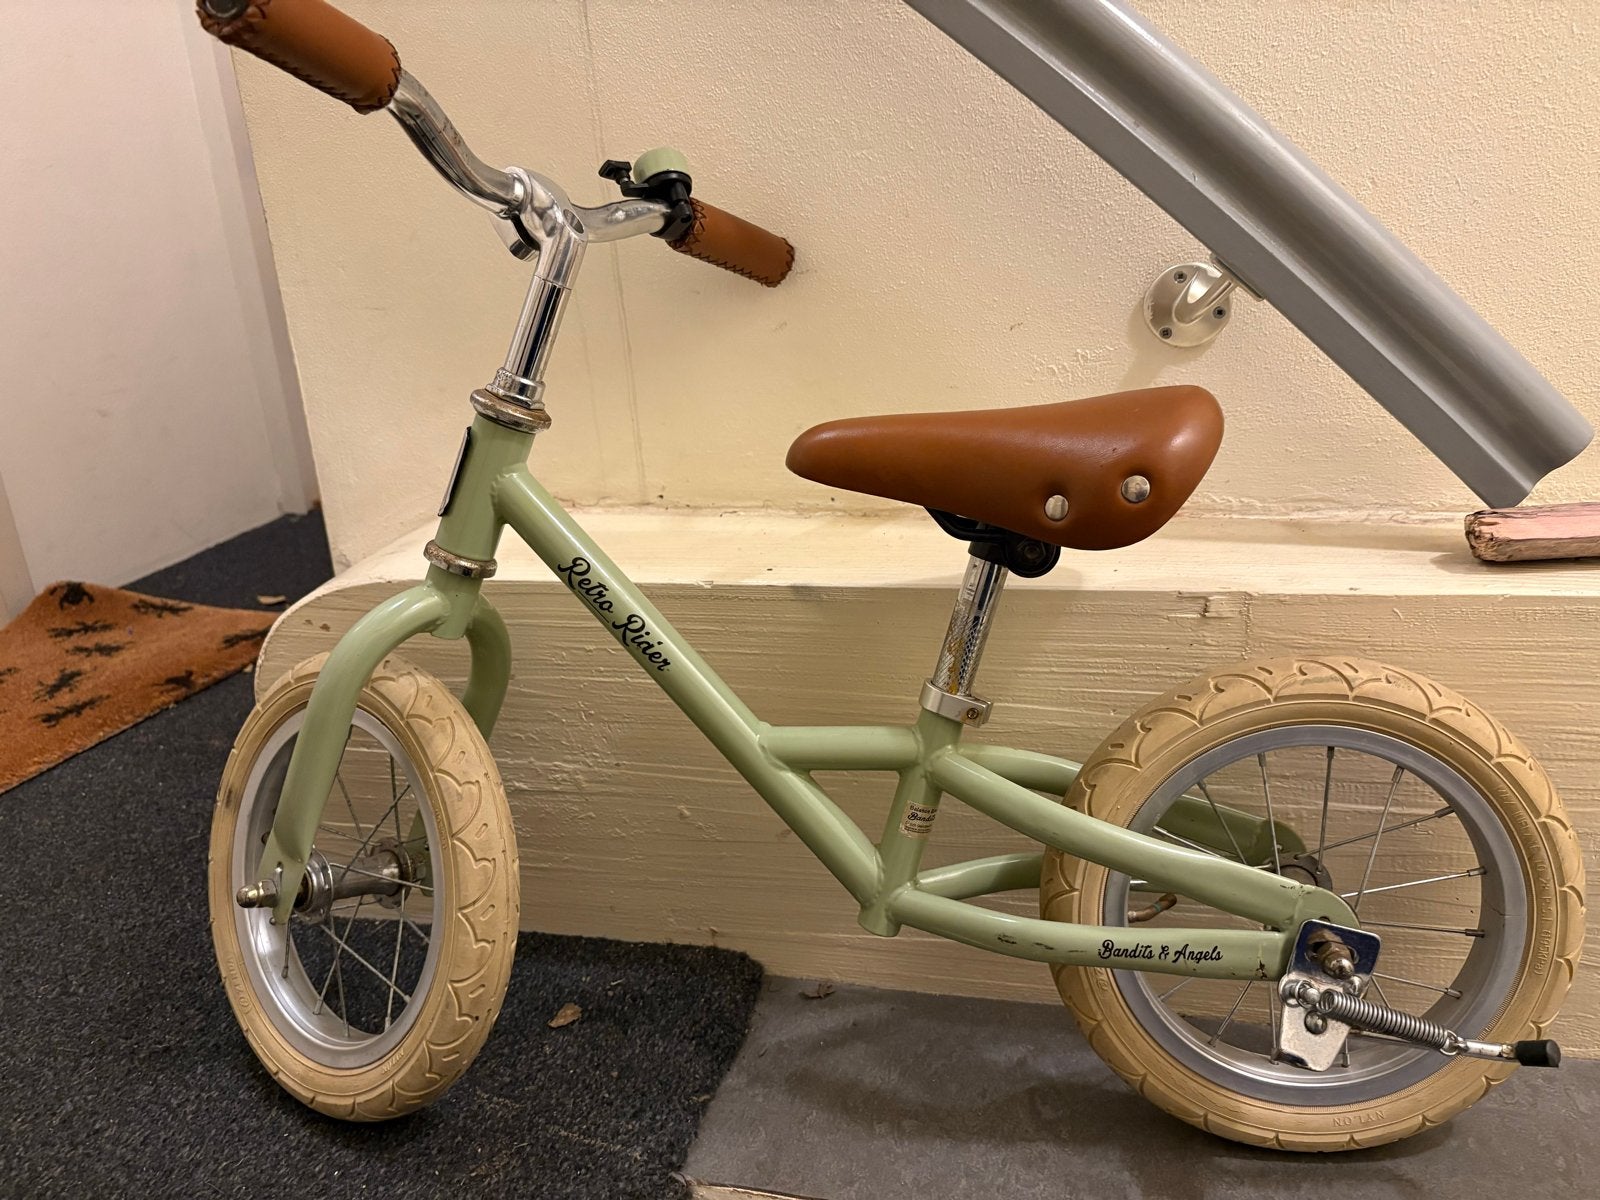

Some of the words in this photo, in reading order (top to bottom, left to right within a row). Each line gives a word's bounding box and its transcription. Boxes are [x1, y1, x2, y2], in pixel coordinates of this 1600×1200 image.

[557, 556, 614, 613] Retro
[612, 613, 671, 671] Rider
[1098, 939, 1155, 960] Bandits
[1158, 944, 1170, 960] &
[1171, 943, 1224, 964] Angels
[1333, 1110, 1385, 1127] NYLON
